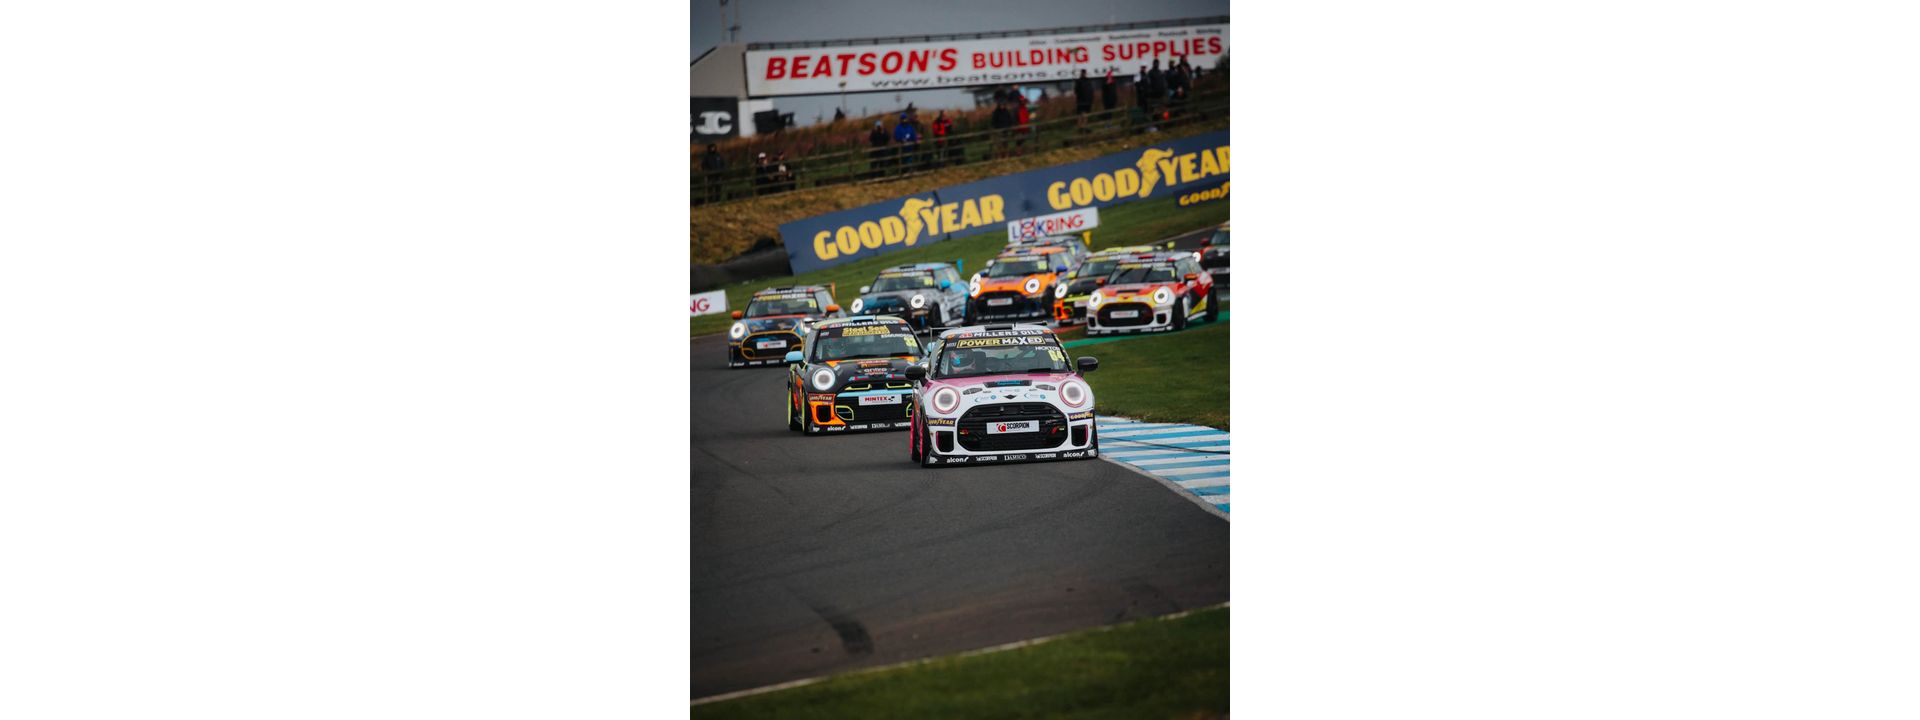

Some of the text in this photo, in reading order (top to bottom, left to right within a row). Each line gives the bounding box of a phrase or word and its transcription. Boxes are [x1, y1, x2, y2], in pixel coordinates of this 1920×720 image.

[765, 48, 958, 80] BEATSON'S
[972, 46, 1090, 69] BUILDING
[1103, 36, 1222, 62] SUPPLIES
[813, 194, 1005, 261] GOODYEAR
[974, 330, 1018, 338] MILLERS
[959, 338, 1001, 347] POWER
[1002, 336, 1043, 346] MAXED
[1006, 422, 1030, 430] SCORPION
